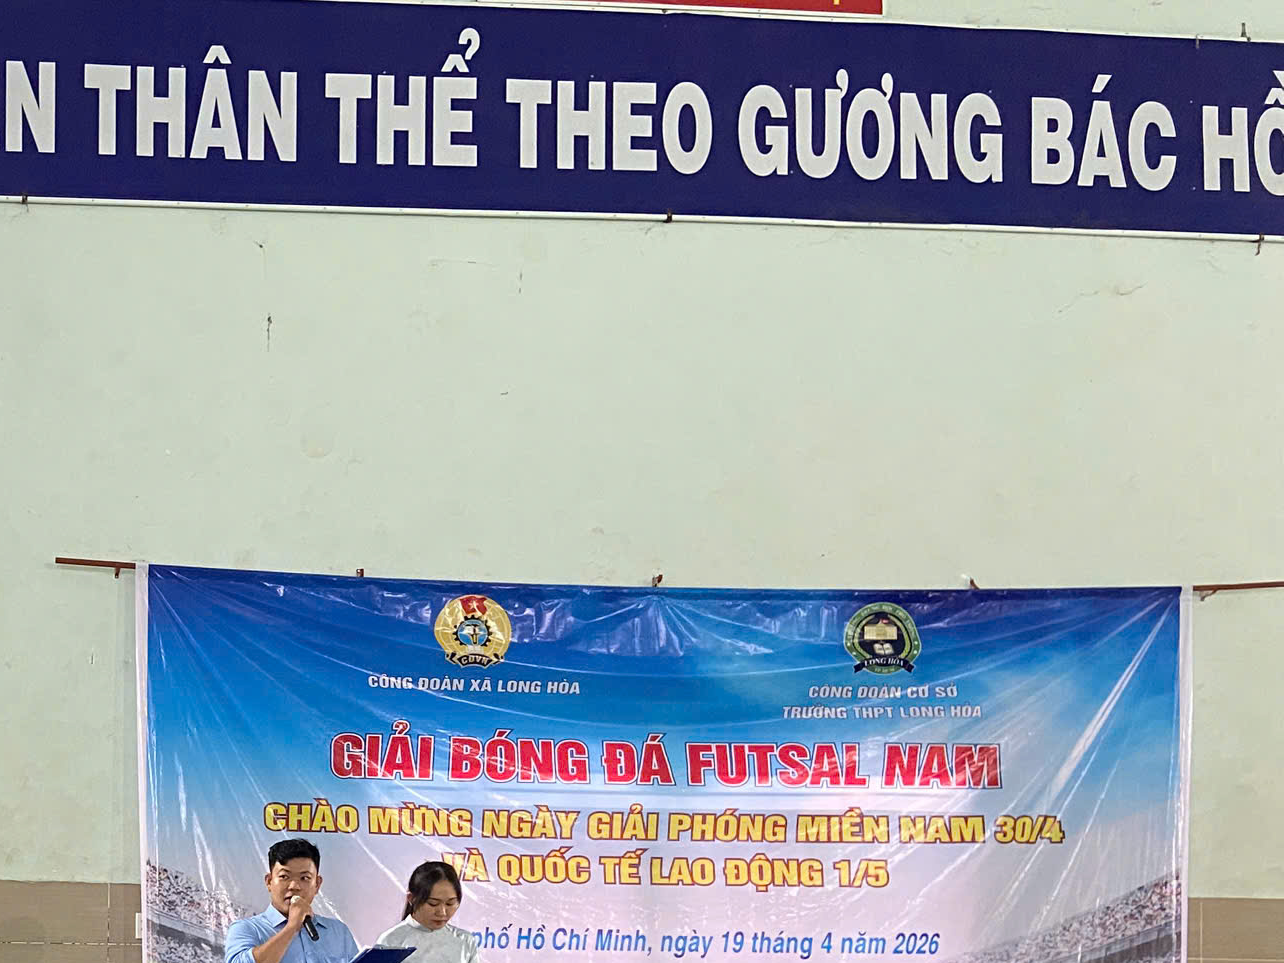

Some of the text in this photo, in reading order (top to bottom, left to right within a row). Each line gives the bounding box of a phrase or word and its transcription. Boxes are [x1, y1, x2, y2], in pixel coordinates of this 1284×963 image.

[84, 45, 297, 163] THÂN
[324, 27, 480, 169] THỂ
[506, 78, 713, 176] THEO
[738, 69, 1004, 184] GƯƠNG
[1030, 74, 1178, 192] BÁC
[367, 674, 581, 696] CÔNG ĐOÀN XÃ LONG HÒA
[808, 681, 852, 699] CÔNG
[856, 681, 901, 699] ĐOÀN
[906, 683, 930, 699] CƠ
[782, 702, 847, 720] TRƯỜNG
[853, 705, 894, 719] THPT
[899, 705, 945, 719] LONG
[330, 719, 1003, 790] GIẢI BÓNG ĐÁ FUTSAL NAM
[263, 797, 1066, 845] CHÀO MỪNG NGÀY GIẢI PHÓNG MIỀN NAM 30/4
[497, 846, 591, 885] QUỐC
[599, 847, 649, 885] TẾ
[649, 856, 715, 887] LAO
[723, 853, 824, 893] ĐỘNG
[833, 858, 890, 888] 1/5
[517, 924, 546, 950] Hồ
[552, 925, 588, 951] Chí
[594, 928, 652, 956] Minh,
[660, 931, 713, 959] ngày
[721, 931, 744, 953] 19
[751, 931, 813, 959] tháng
[820, 933, 832, 954] 4
[840, 931, 887, 955] năm
[892, 933, 940, 955] 2026
